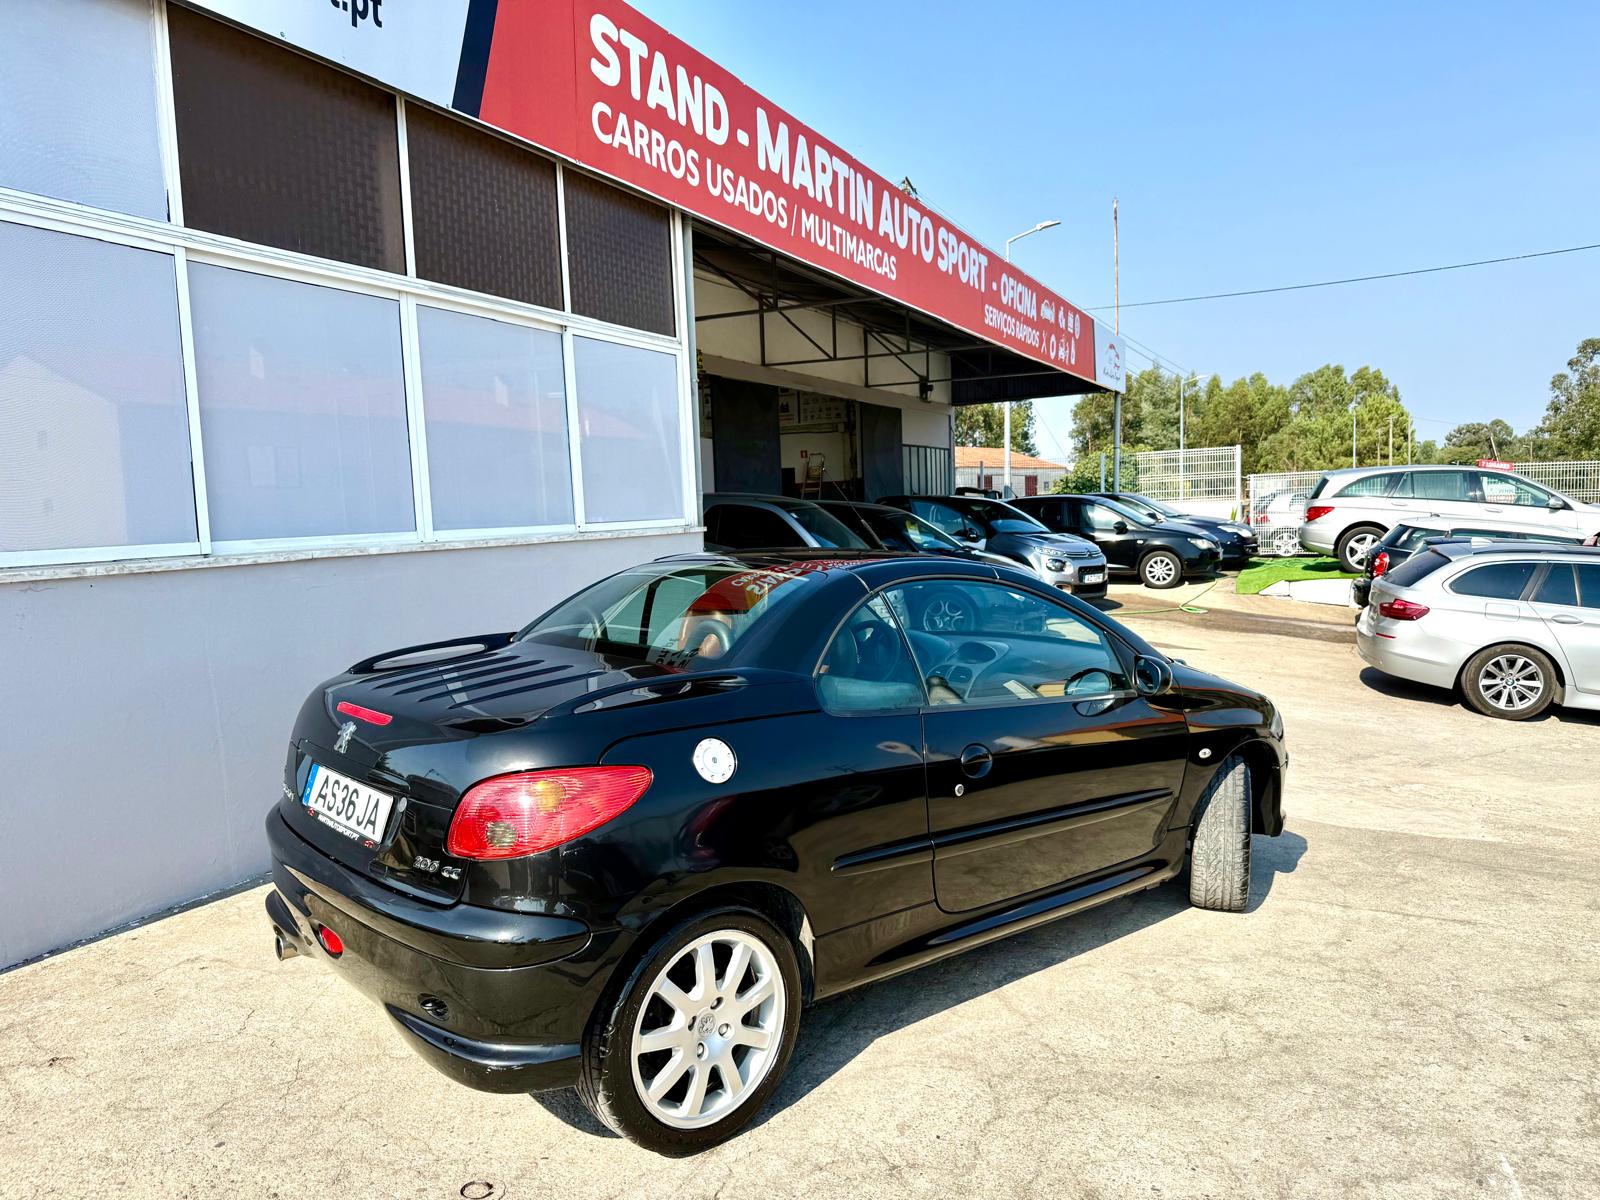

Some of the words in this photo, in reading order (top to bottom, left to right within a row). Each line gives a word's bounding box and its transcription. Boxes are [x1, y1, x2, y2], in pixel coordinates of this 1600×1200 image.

[590, 14, 729, 146] STAND
[757, 107, 873, 231] MARTIN
[879, 190, 934, 263] AUTO
[938, 226, 988, 292] SPORT
[1001, 273, 1038, 321] OFICINA
[592, 102, 700, 187] CARROS
[706, 157, 788, 229] USADOS
[801, 208, 897, 281] MULTIMARCAS
[984, 303, 1016, 338] SERVIÇOS
[1015, 316, 1040, 348] RÁPIDOS
[314, 774, 360, 822] AS36
[356, 794, 380, 835] JA
[413, 855, 440, 873] 206
